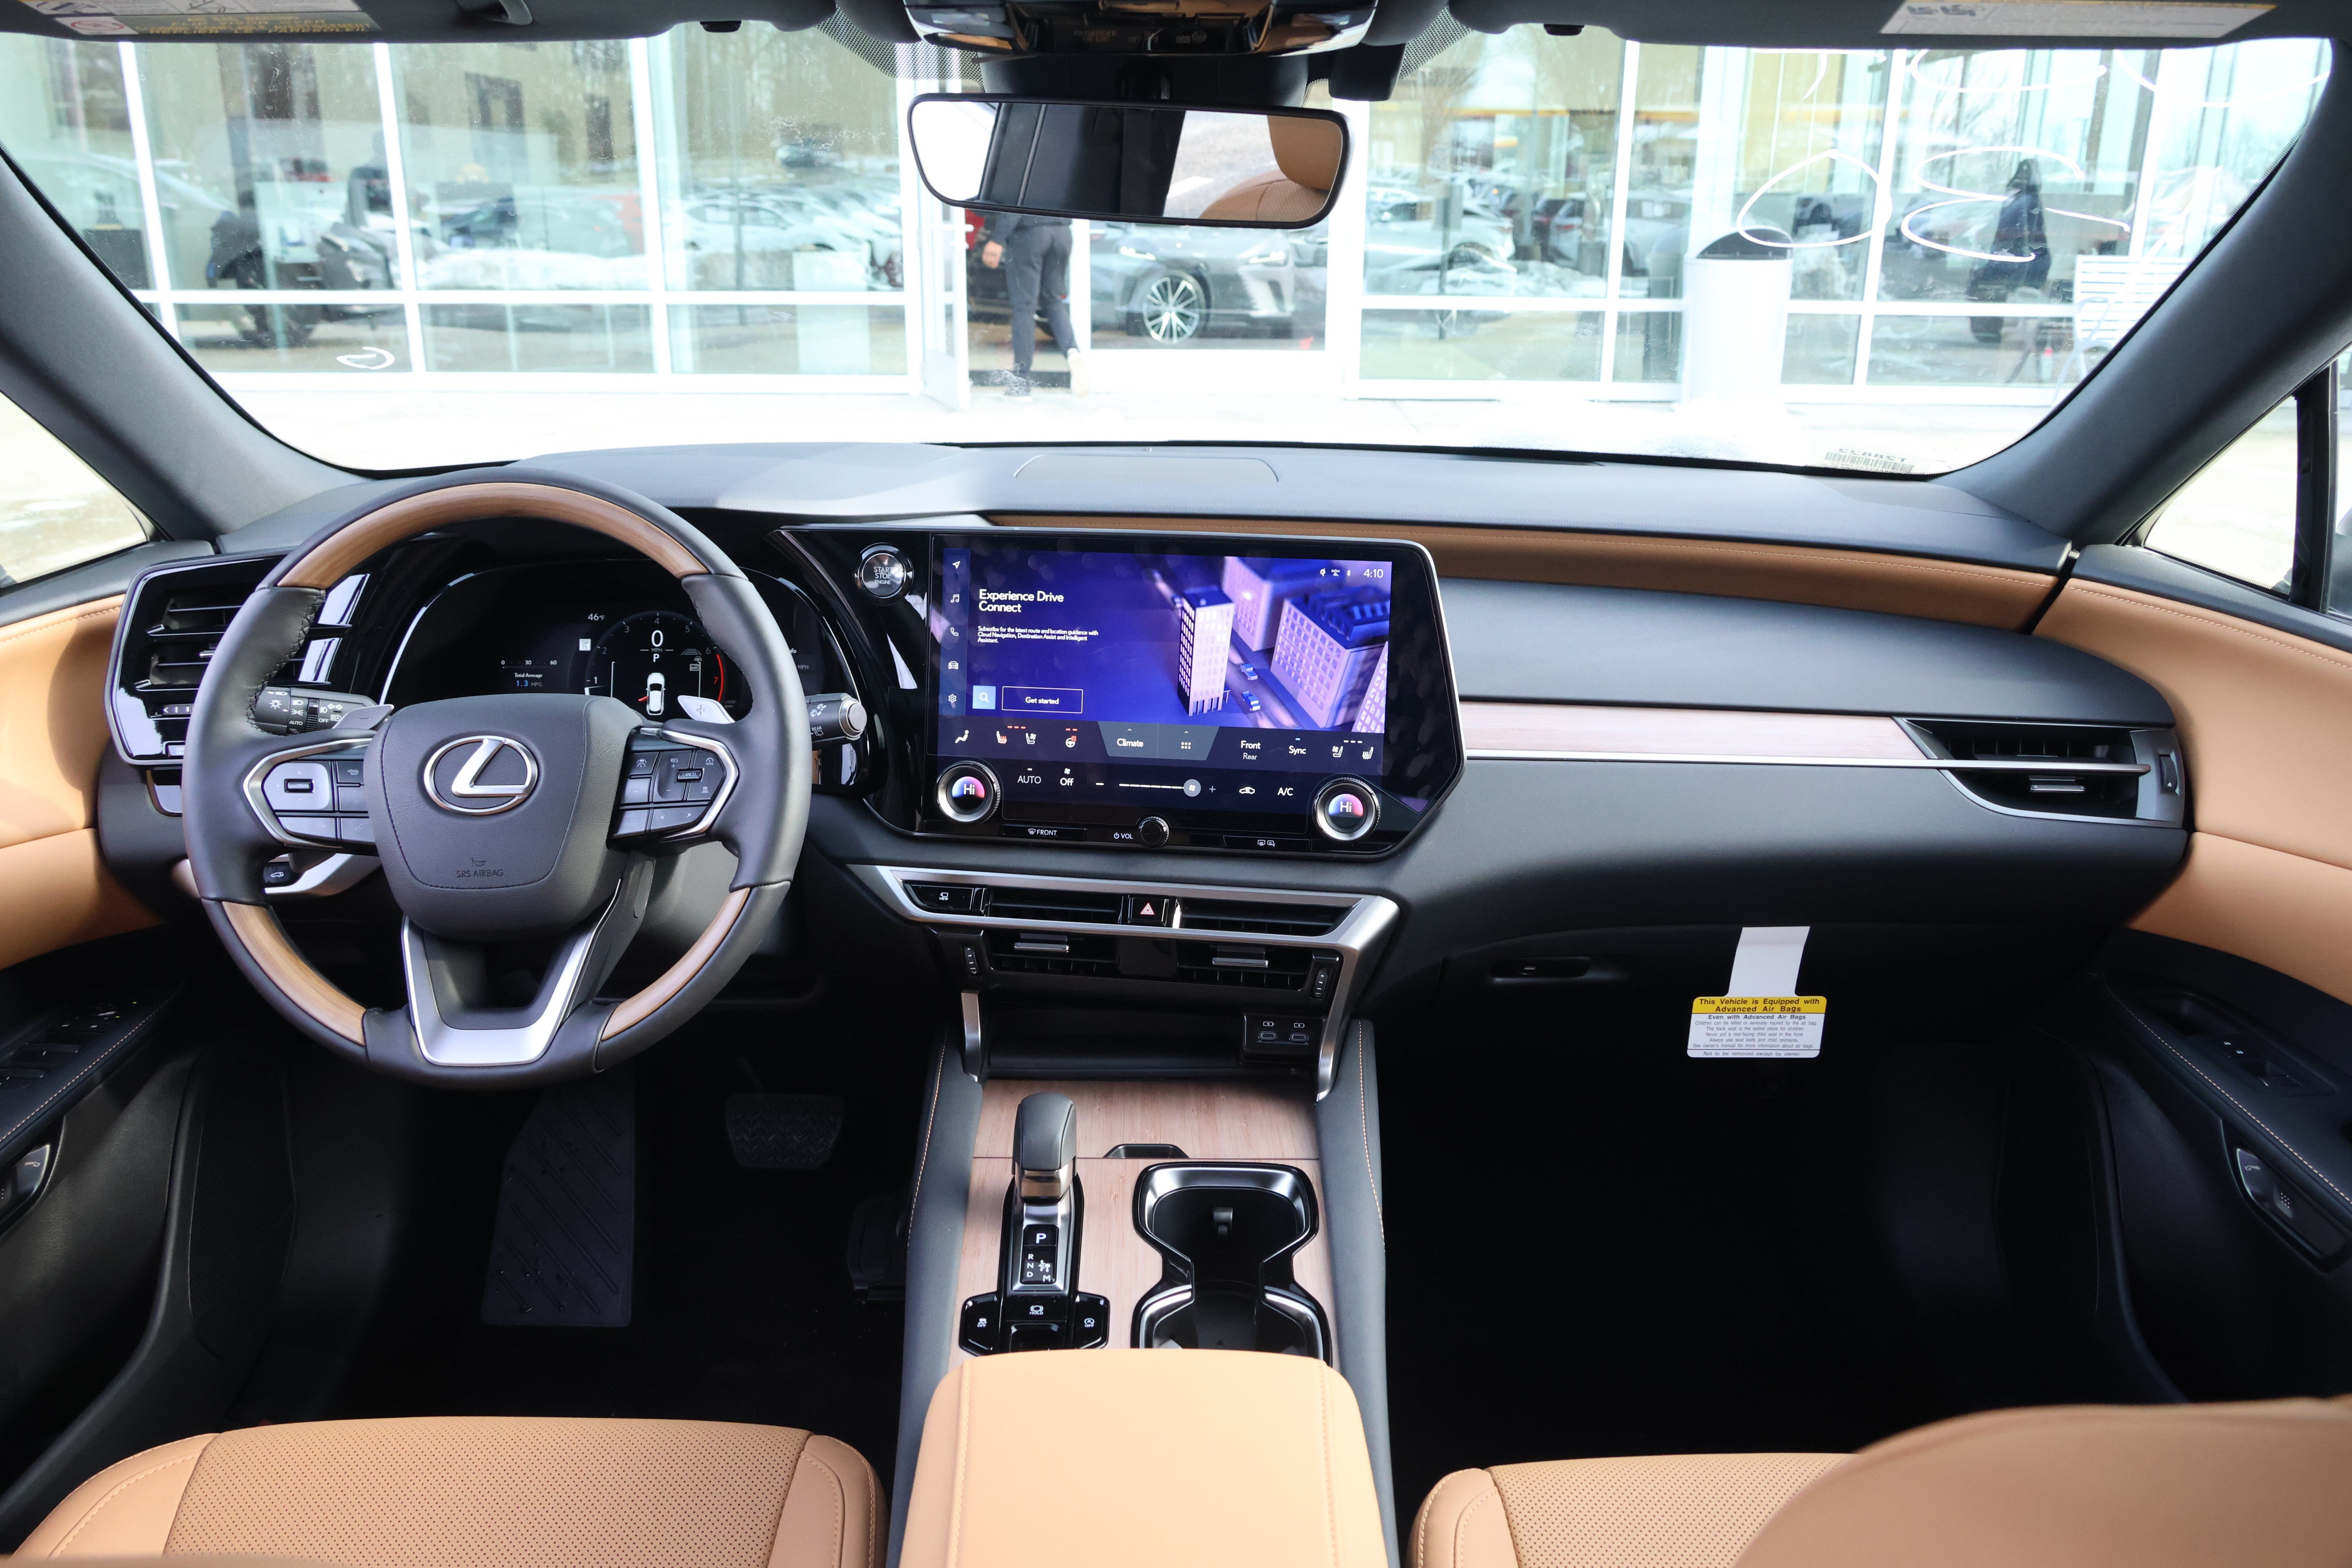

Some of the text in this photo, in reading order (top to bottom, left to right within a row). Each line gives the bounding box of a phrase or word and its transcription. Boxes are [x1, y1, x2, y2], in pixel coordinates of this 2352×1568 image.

[1364, 569, 1383, 578] 4:10
[979, 589, 1064, 602] Experience Drive
[979, 601, 1021, 612] Connect
[652, 630, 663, 647] 0
[653, 654, 659, 662] P
[1117, 738, 1143, 747] Climate
[1241, 740, 1261, 749] Front
[1289, 746, 1306, 755] Sync
[1018, 775, 1041, 784] AUTO
[964, 784, 975, 795] Hi
[1278, 788, 1293, 796] A/C
[1340, 802, 1352, 813] Hi
[1036, 1233, 1046, 1243] P
